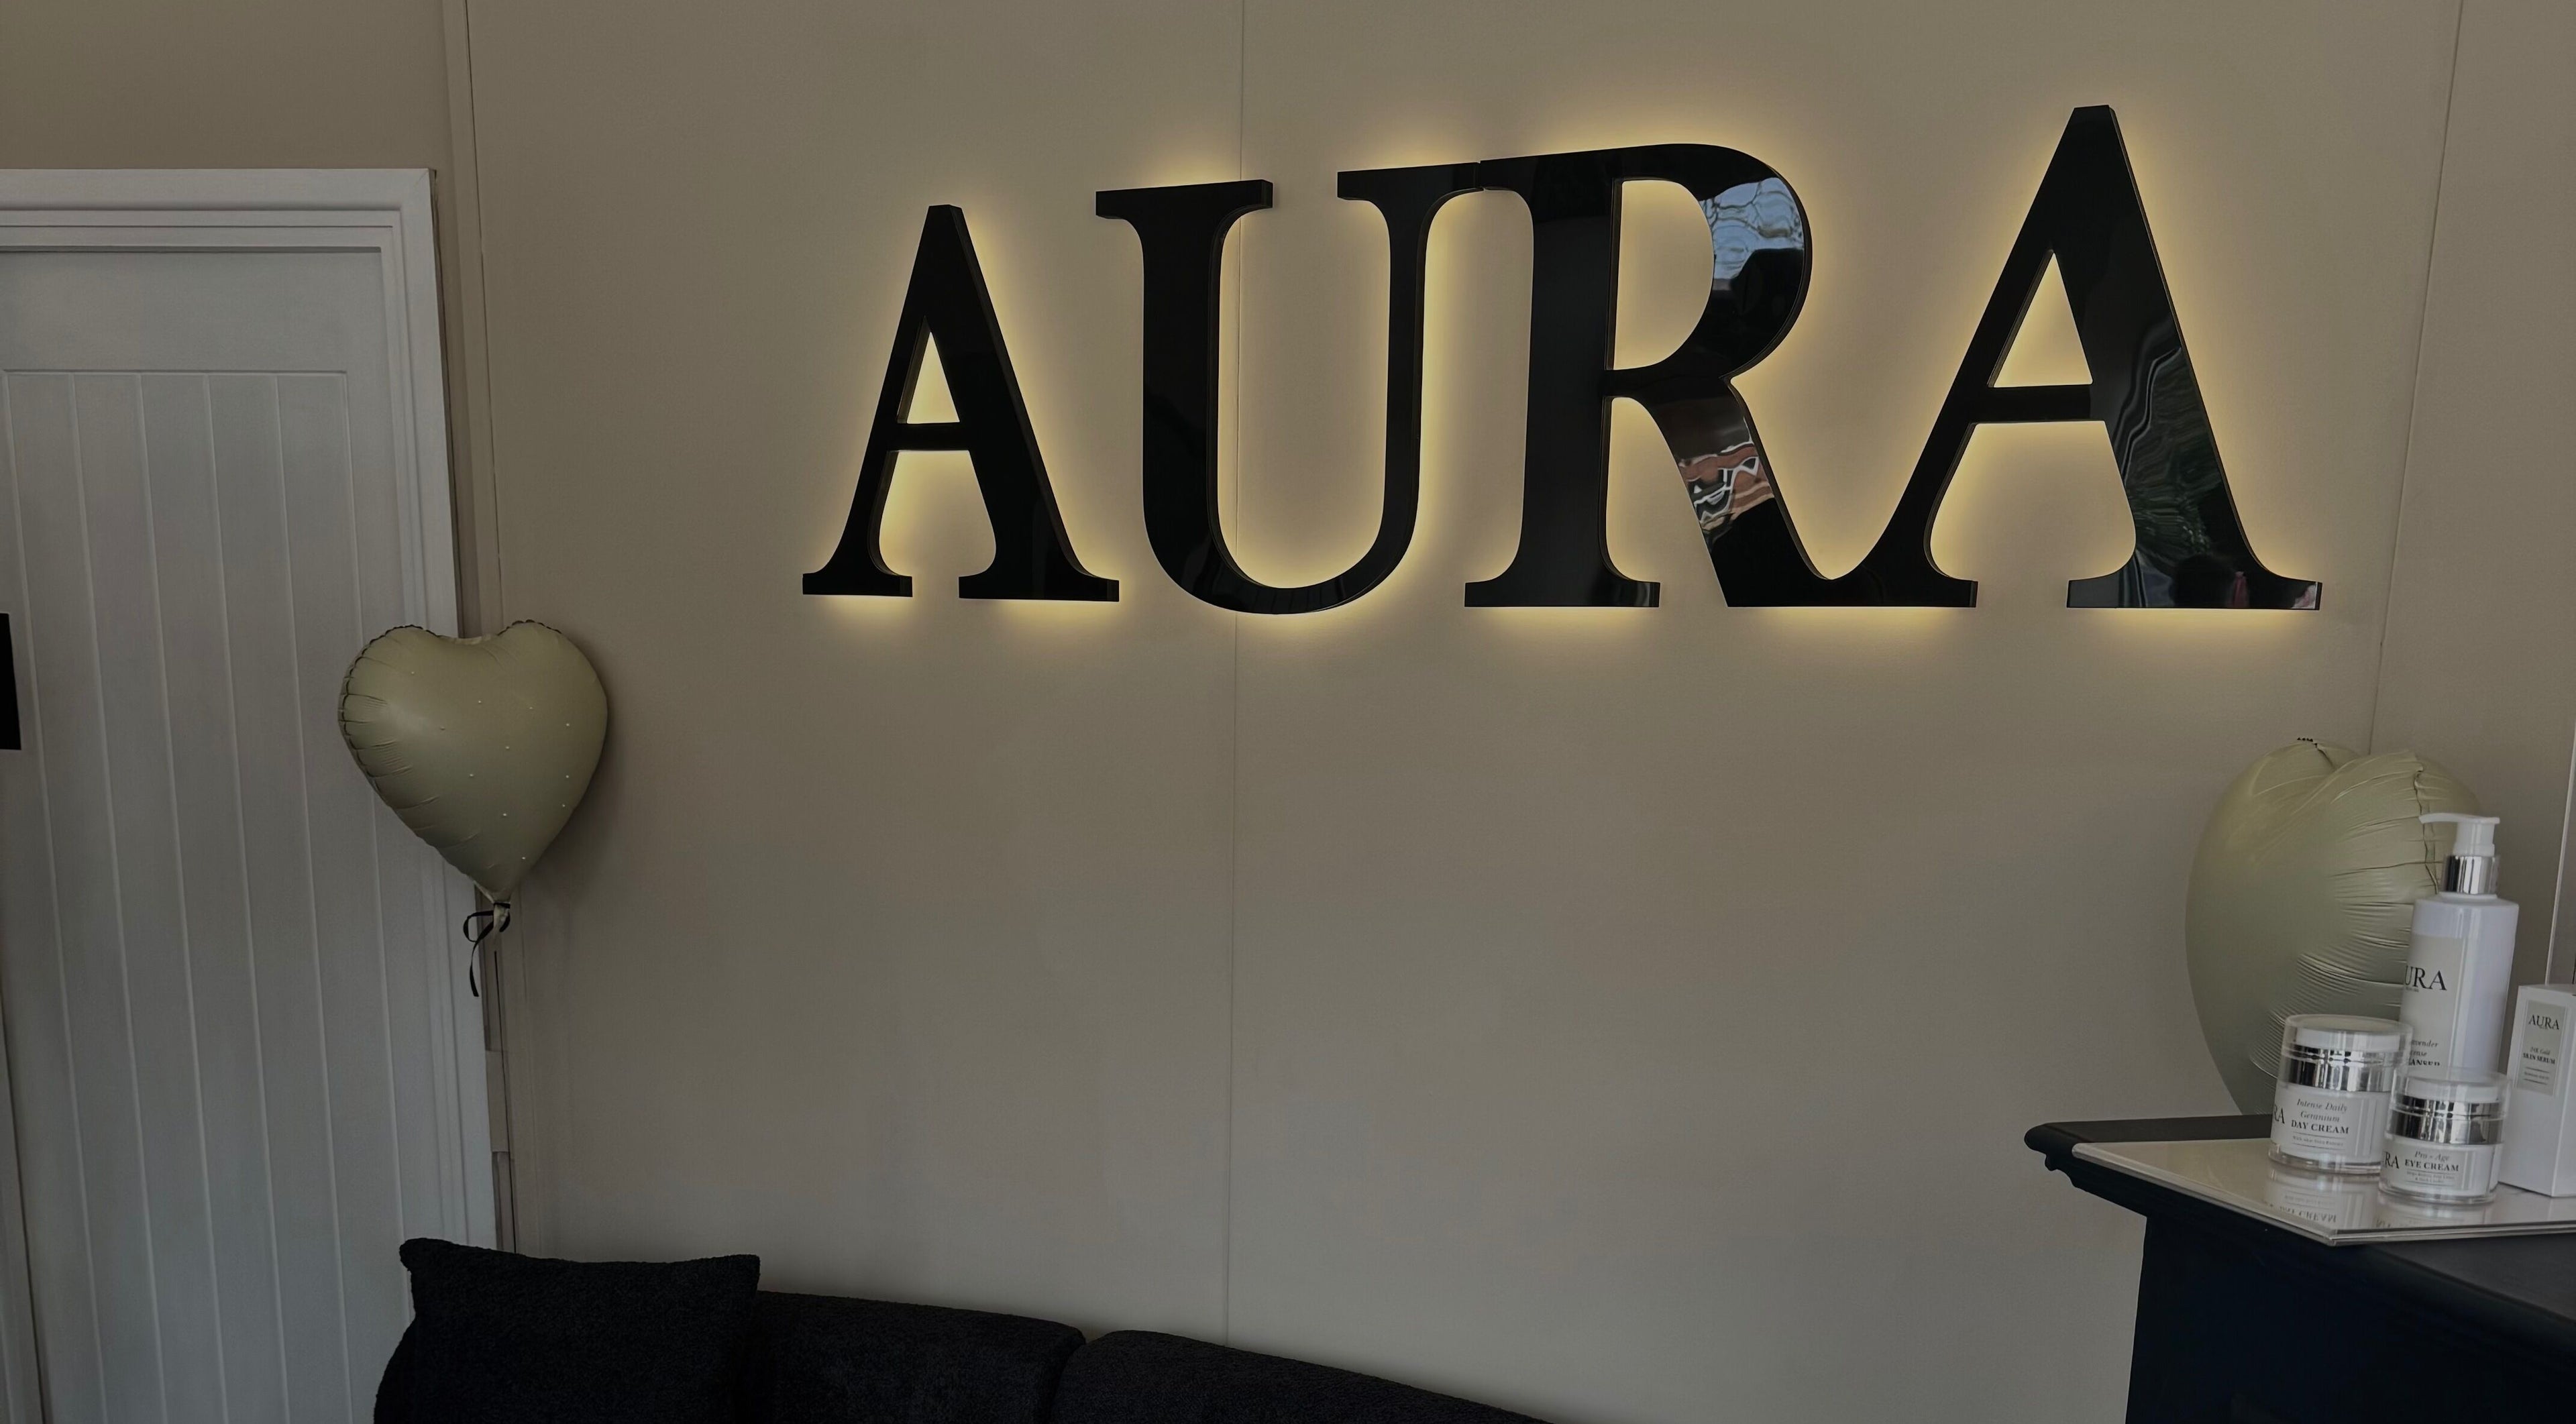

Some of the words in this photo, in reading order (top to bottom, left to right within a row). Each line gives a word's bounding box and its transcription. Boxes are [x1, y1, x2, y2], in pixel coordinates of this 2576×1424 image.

[802, 104, 2322, 616] AURA
[2528, 1014, 2559, 1030] AURA
[2523, 1052, 2536, 1061] SKIN
[2537, 1055, 2555, 1065] SERUM
[2297, 1099, 2322, 1109] Intense
[2325, 1102, 2347, 1114] Daily
[2300, 1111, 2340, 1123] Geranium
[2291, 1119, 2309, 1130] DAY
[2311, 1124, 2349, 1134] CREAM
[2415, 1151, 2427, 1159] Pro
[2404, 1158, 2422, 1168] EYE
[2424, 1162, 2459, 1172] CREAM
